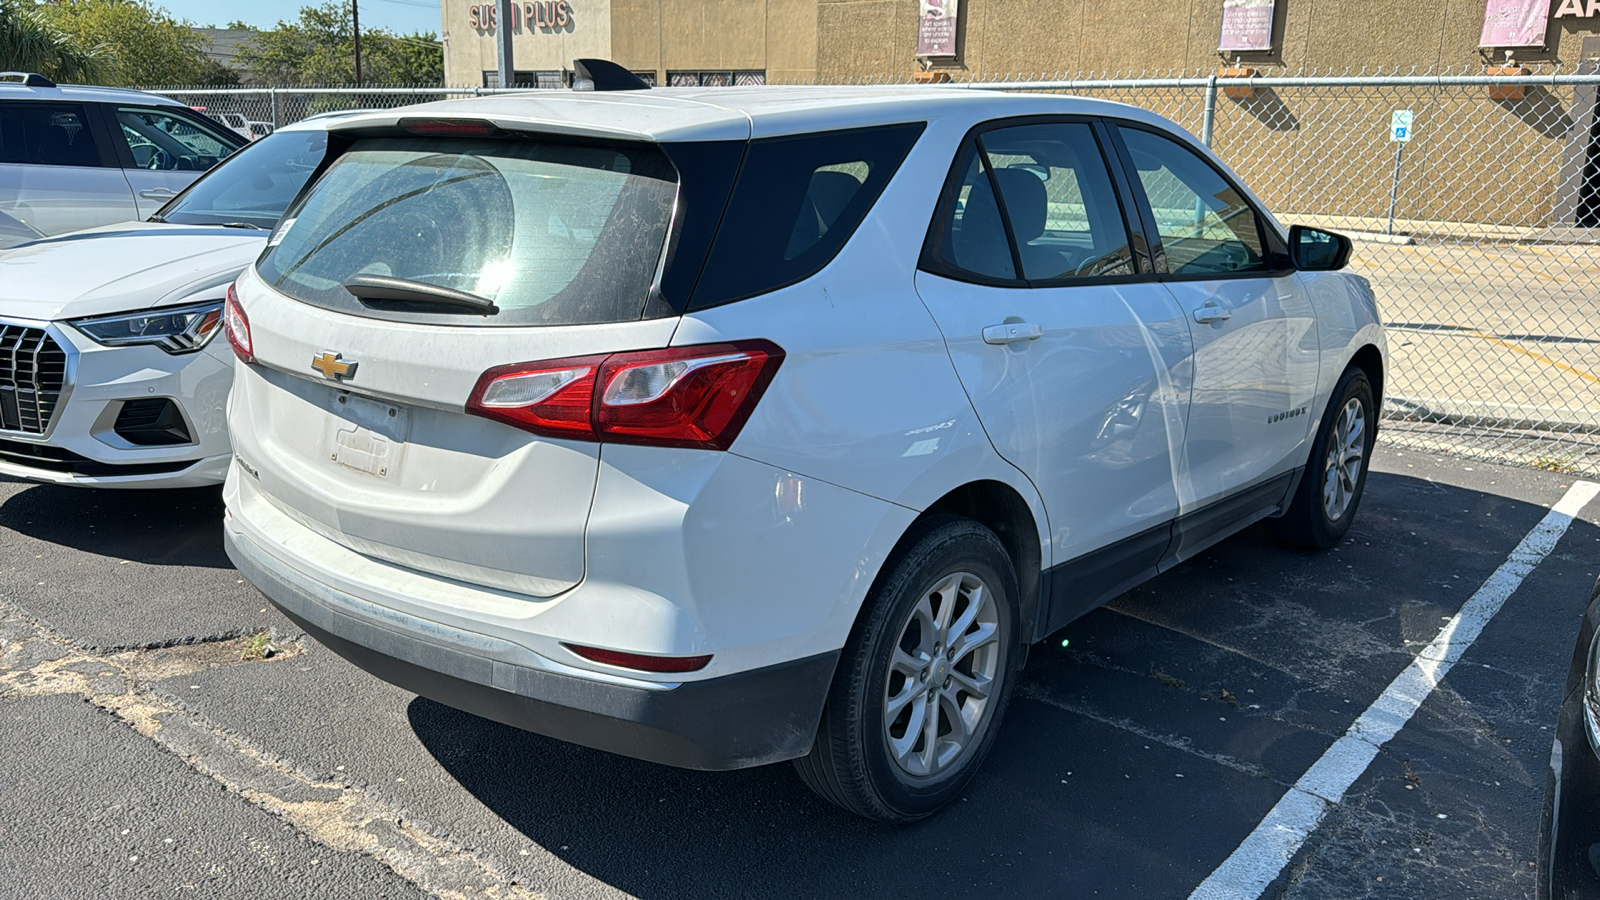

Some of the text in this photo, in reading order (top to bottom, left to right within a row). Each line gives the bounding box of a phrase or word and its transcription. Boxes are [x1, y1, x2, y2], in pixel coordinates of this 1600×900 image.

[470, 1, 567, 29] SUSI PLUS
[1268, 407, 1307, 424] EQUINOX
